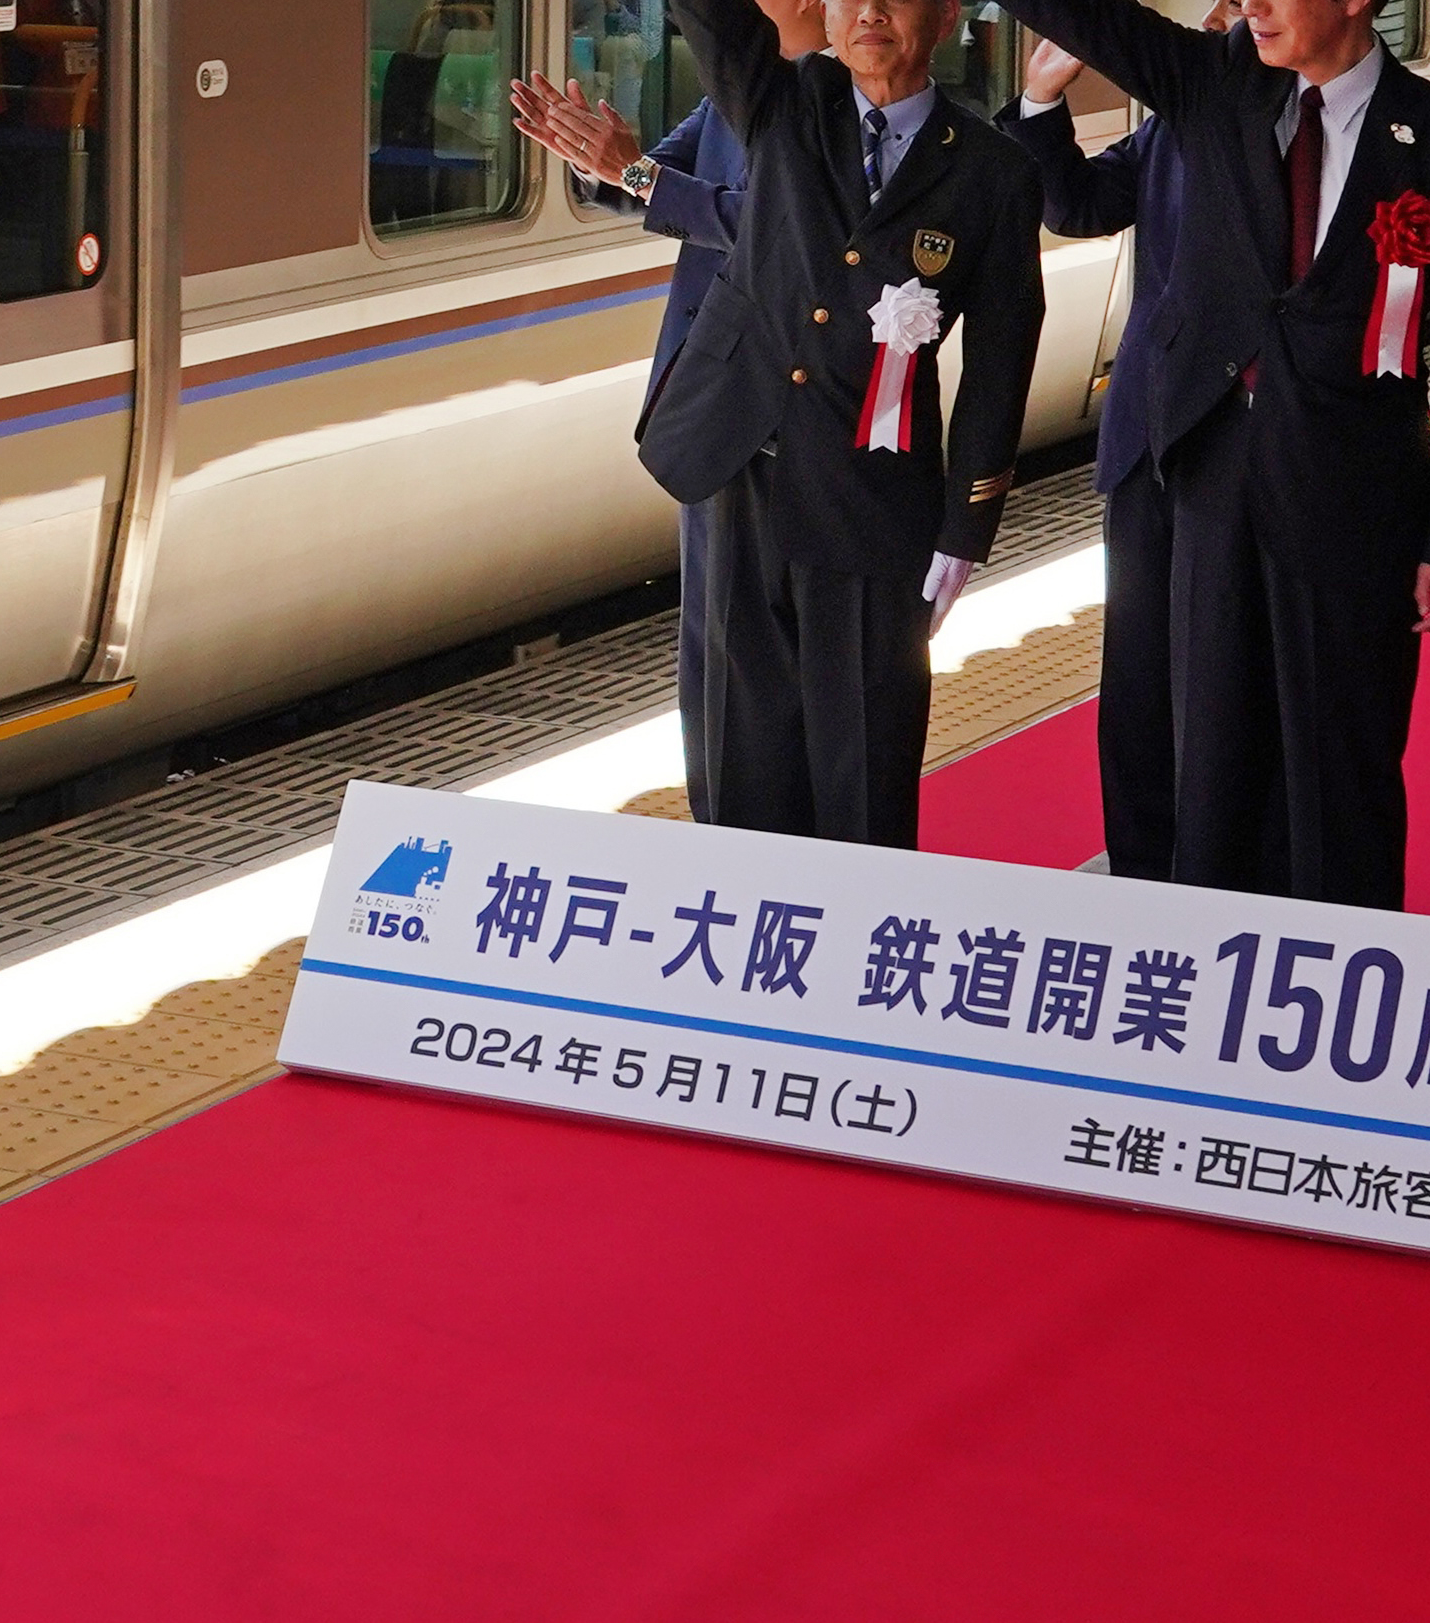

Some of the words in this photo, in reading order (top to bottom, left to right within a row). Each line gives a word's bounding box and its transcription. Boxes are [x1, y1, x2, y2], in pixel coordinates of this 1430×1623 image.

[476, 862, 825, 999] 神戸-大阪
[410, 1017, 918, 1137] 2024年5月11日(土)
